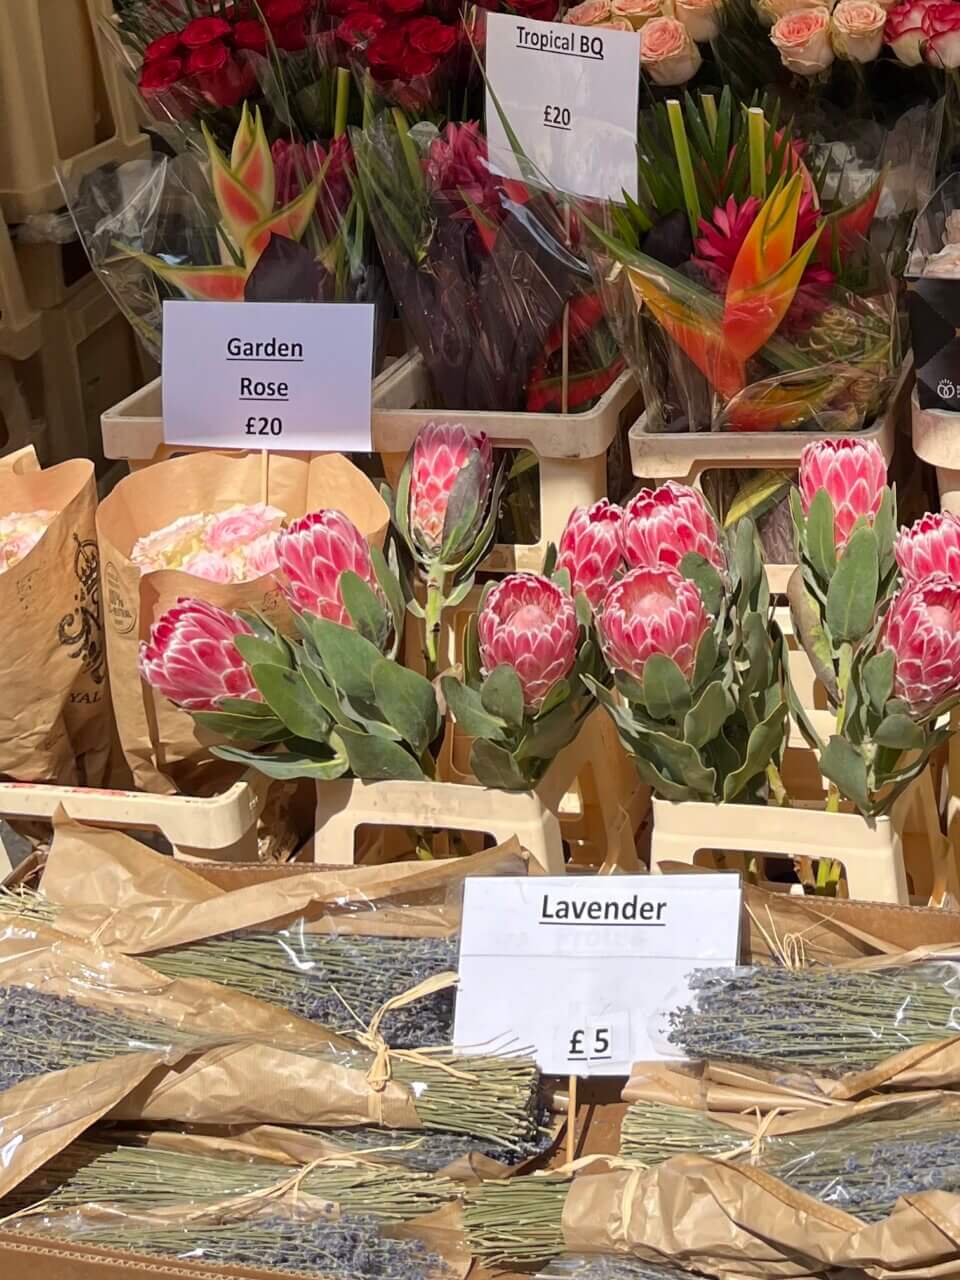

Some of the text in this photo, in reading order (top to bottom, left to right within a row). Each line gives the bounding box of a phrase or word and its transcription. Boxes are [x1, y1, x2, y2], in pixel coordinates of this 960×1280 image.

[516, 25, 605, 59] Tropical BQ
[543, 104, 571, 127] £20
[227, 337, 304, 357] Garden
[239, 376, 290, 397] Rose
[245, 416, 283, 437] £20
[541, 894, 667, 921] Lavender
